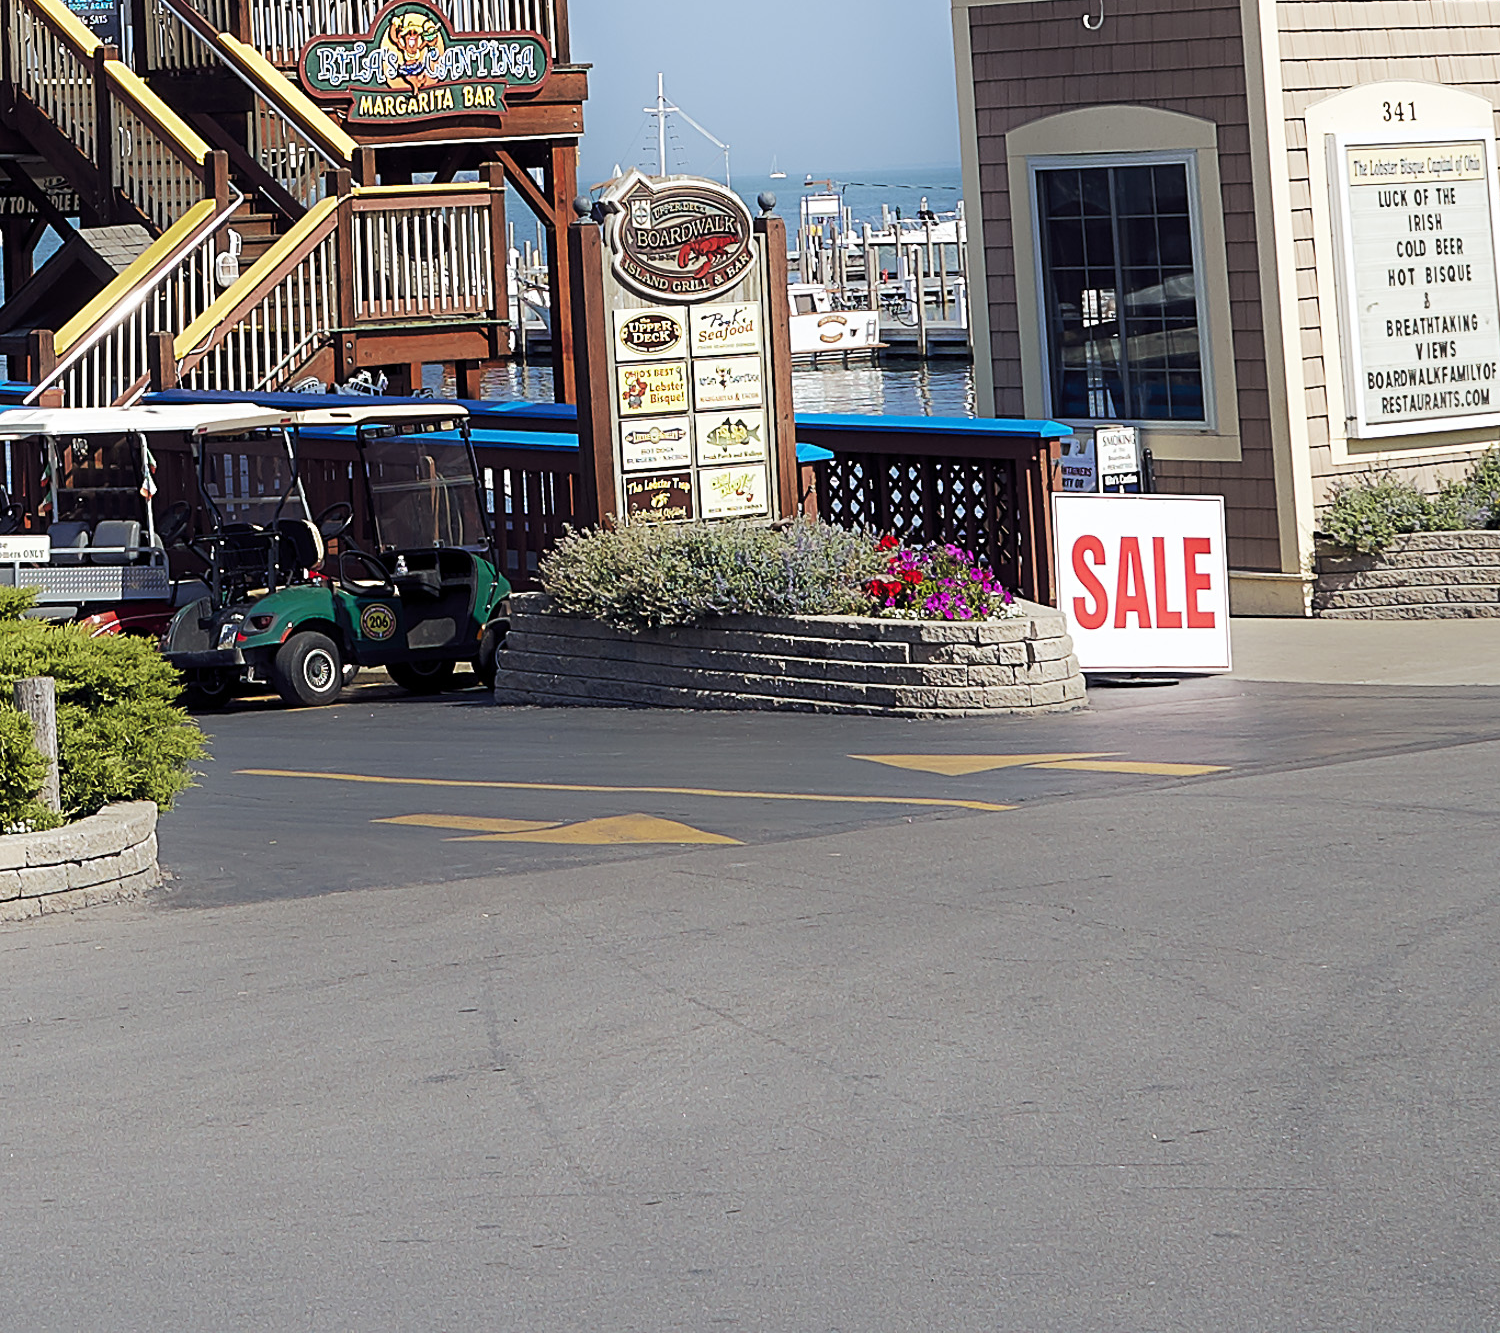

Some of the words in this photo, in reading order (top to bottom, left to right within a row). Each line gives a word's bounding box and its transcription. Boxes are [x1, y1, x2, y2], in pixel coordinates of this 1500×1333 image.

[90, 2, 114, 10] AGAVE
[316, 42, 399, 86] RITA'S
[422, 39, 537, 84] CANTINA
[359, 87, 455, 117] MARGARITA
[462, 85, 497, 108] BAR
[1382, 101, 1417, 122] 341
[1353, 160, 1368, 177] The
[1369, 158, 1398, 176] Lobster
[1399, 157, 1425, 179] Bisque
[9, 196, 25, 214] TO
[1378, 189, 1408, 208] LUCK
[1413, 188, 1429, 207] OF
[1435, 187, 1456, 205] THE
[636, 216, 737, 247] BOARDWALK
[1408, 213, 1443, 232] IRISH
[1396, 239, 1426, 258] COLD
[1435, 237, 1464, 256] BEER
[624, 258, 669, 290] ISLAND
[672, 278, 711, 293] GRILL
[713, 273, 725, 285] &
[725, 253, 750, 278] BAR
[1388, 268, 1415, 287] HOT
[1425, 264, 1472, 284] BISQUE
[628, 320, 673, 333] UPPER
[698, 320, 754, 343] Seafood
[1386, 314, 1479, 337] BREATHTAKING
[632, 331, 671, 344] DECK
[1415, 340, 1457, 361] VIEWS
[653, 367, 675, 377] BEST
[1367, 362, 1497, 391] BOARDWALKFAMILYOF
[649, 380, 684, 393] Lobster
[650, 391, 685, 406] Bisque!
[1380, 387, 1490, 415] RESTAURANTS.COM
[627, 481, 644, 495] The
[644, 477, 672, 491] Lobster
[23, 549, 45, 559] ONLY
[1071, 534, 1216, 630] SALE
[369, 614, 389, 629] 206
